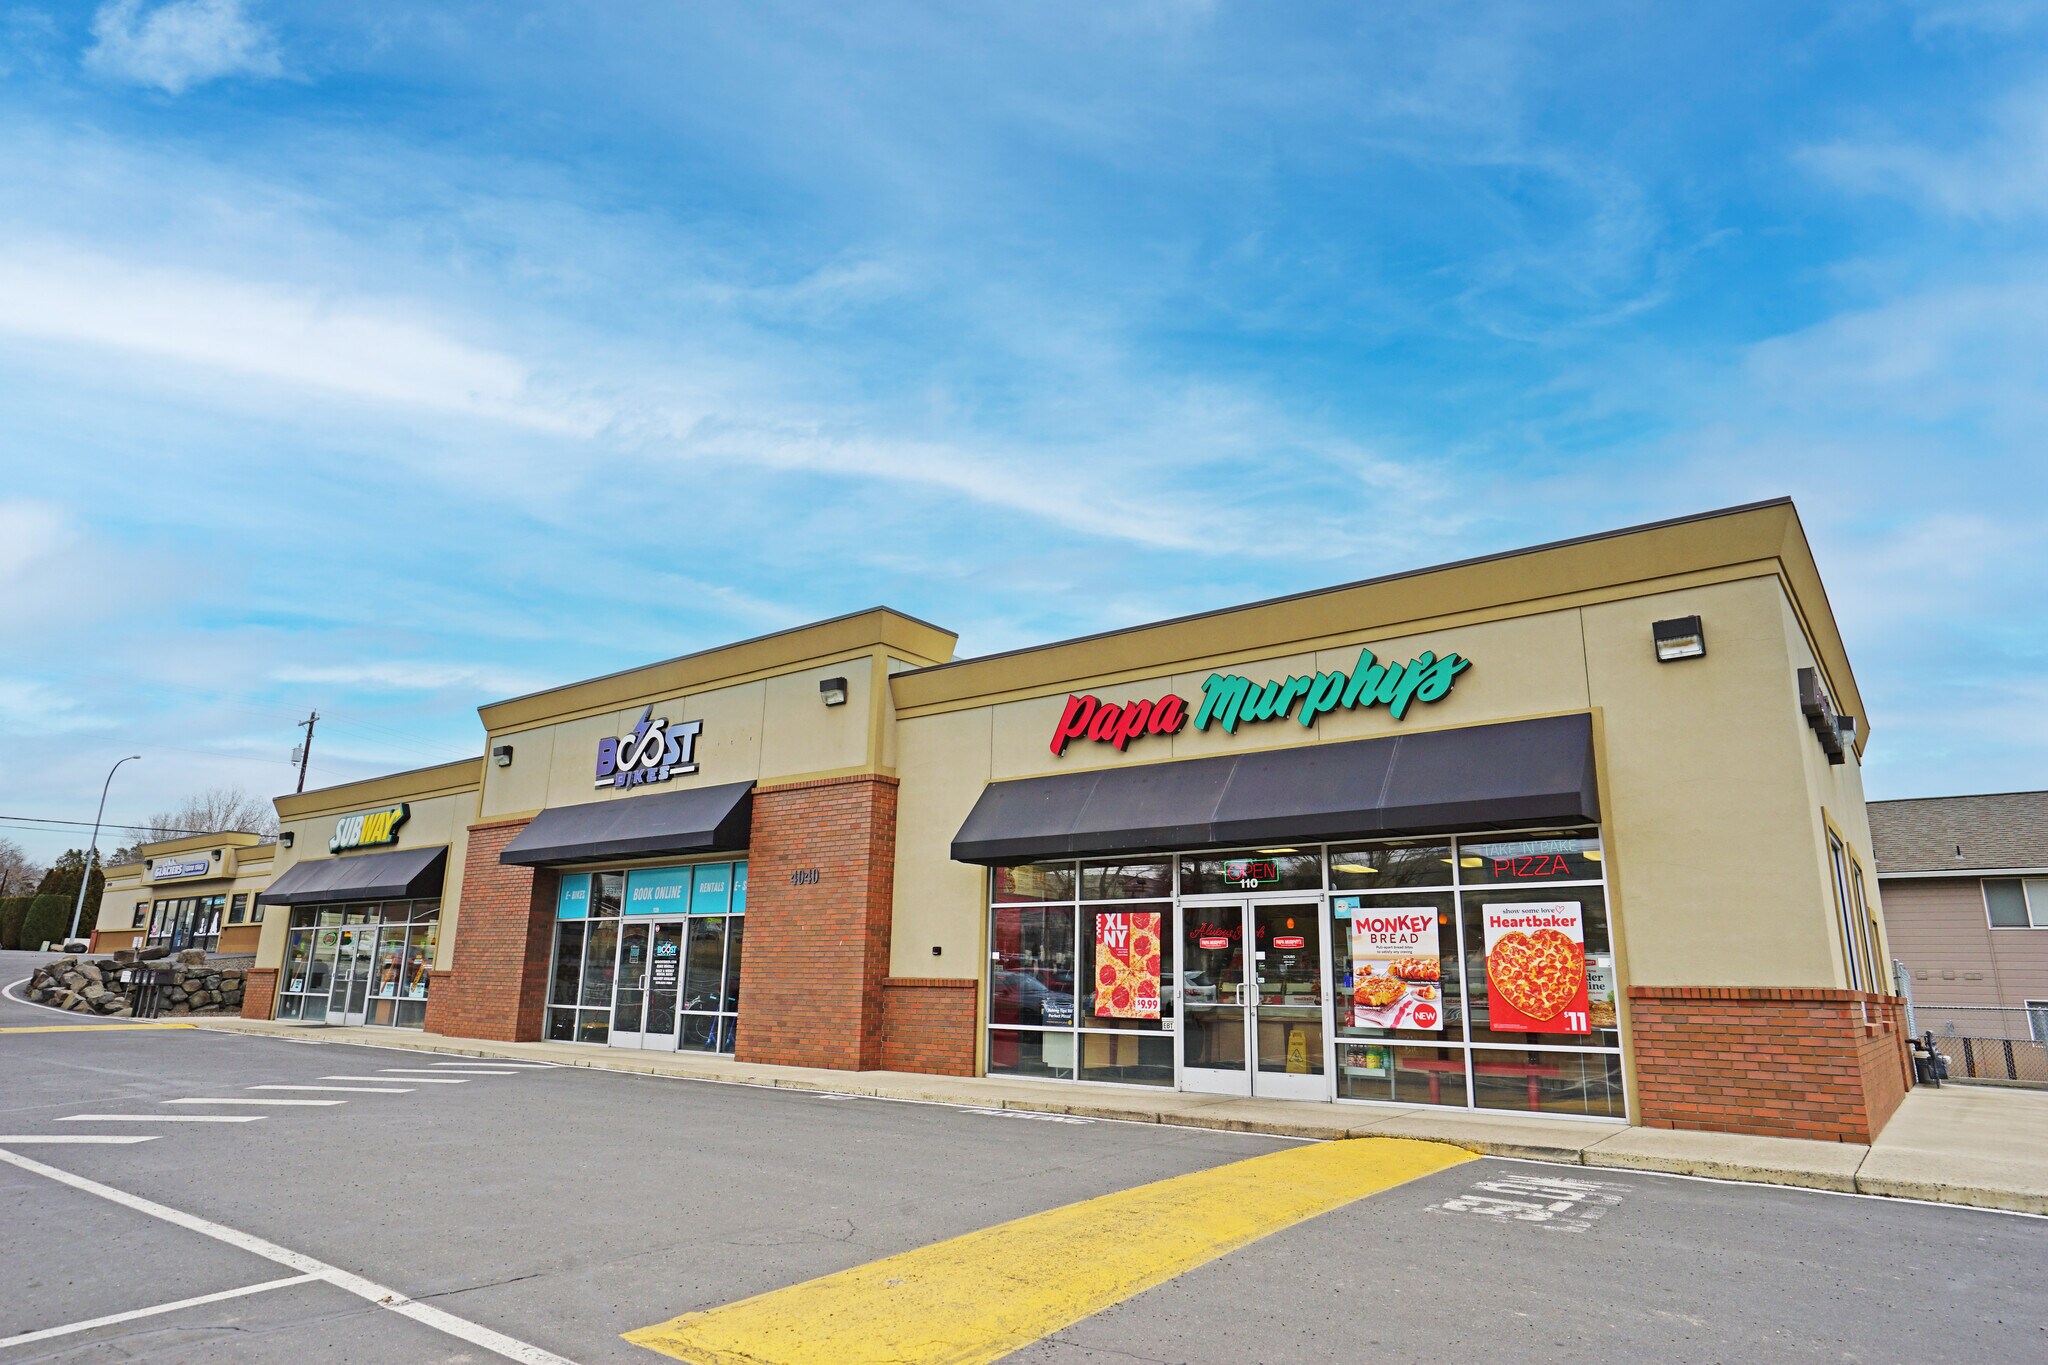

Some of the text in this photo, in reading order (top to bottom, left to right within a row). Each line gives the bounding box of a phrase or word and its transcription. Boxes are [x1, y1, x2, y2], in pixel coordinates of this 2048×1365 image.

[1050, 648, 1472, 757] Papa Murphy's
[596, 717, 703, 776] BOOST
[614, 765, 671, 790] BIKES
[329, 803, 405, 850] SUBWAY
[1483, 844, 1516, 857] TAKE
[1540, 839, 1578, 853] BAKE
[1227, 863, 1276, 881] OPEN
[1493, 855, 1570, 878] PIZZA
[791, 869, 819, 885] 4040
[1239, 878, 1258, 888] 110
[633, 887, 653, 901] BOOK
[654, 885, 682, 899] ONLINE
[699, 881, 724, 893] RENTALS
[1105, 913, 1128, 930] XL
[1355, 914, 1433, 934] MONKEY
[1489, 914, 1577, 928] Heartbaker
[1104, 930, 1128, 948] NY
[1370, 933, 1419, 944] BREAD
[1586, 972, 1604, 982] der
[1137, 999, 1158, 1009] $9.99
[1415, 1011, 1436, 1021] NEW
[1563, 1011, 1587, 1031] $11
